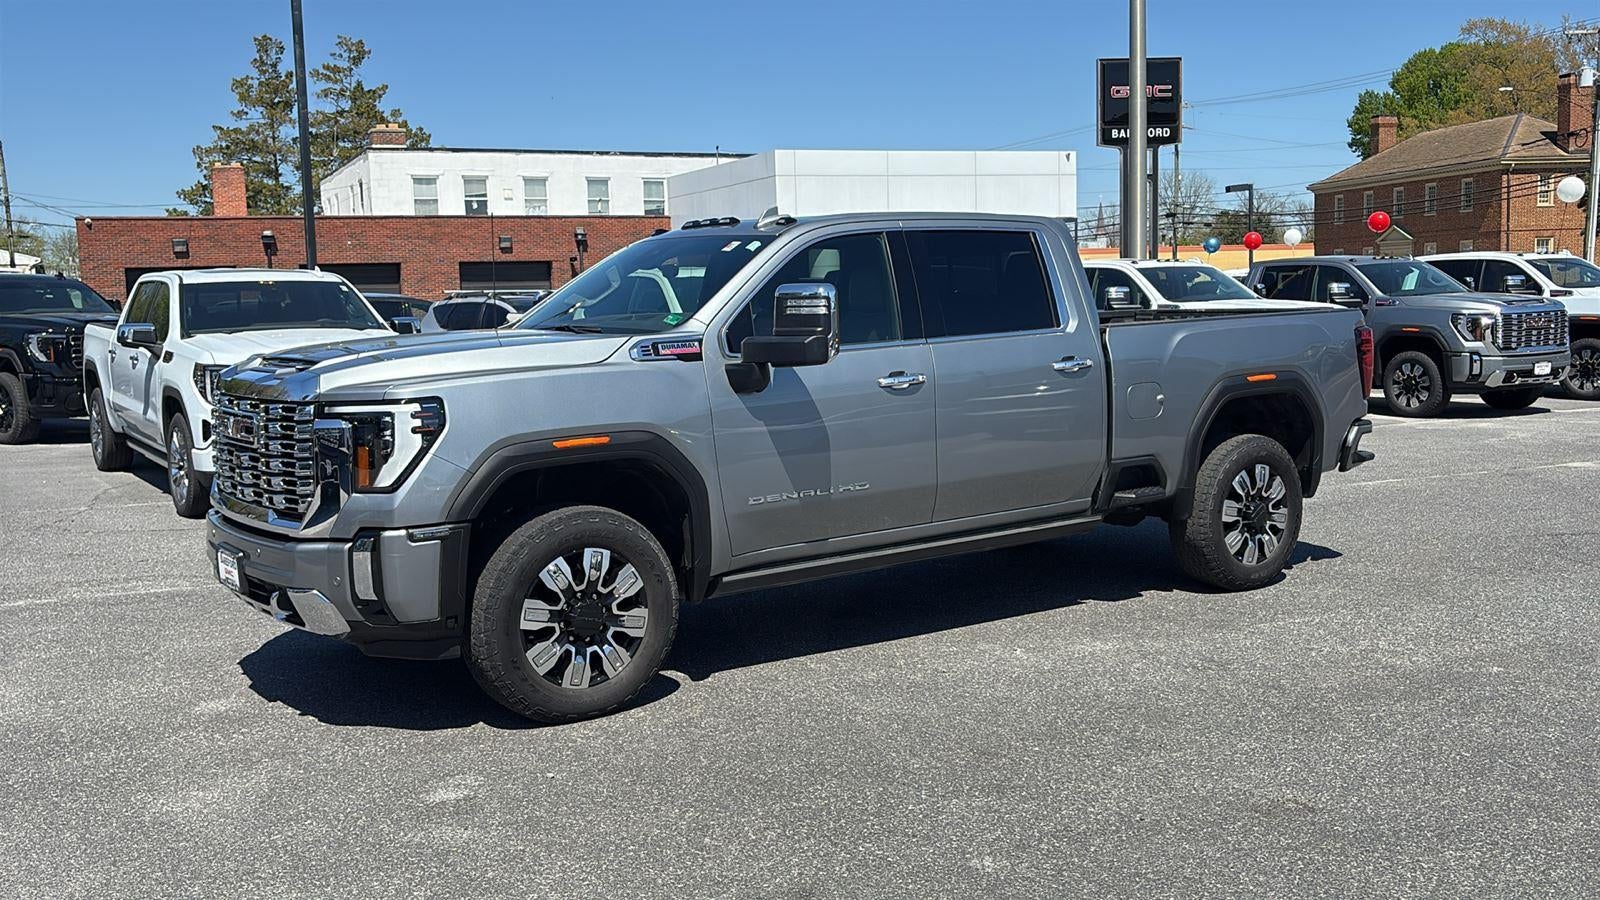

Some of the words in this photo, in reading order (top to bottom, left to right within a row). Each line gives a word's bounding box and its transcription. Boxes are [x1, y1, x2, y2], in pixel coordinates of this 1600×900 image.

[1110, 85, 1172, 98] GC
[661, 342, 697, 350] DURAMAX
[748, 487, 834, 505] DENALI
[839, 481, 869, 492] HD
